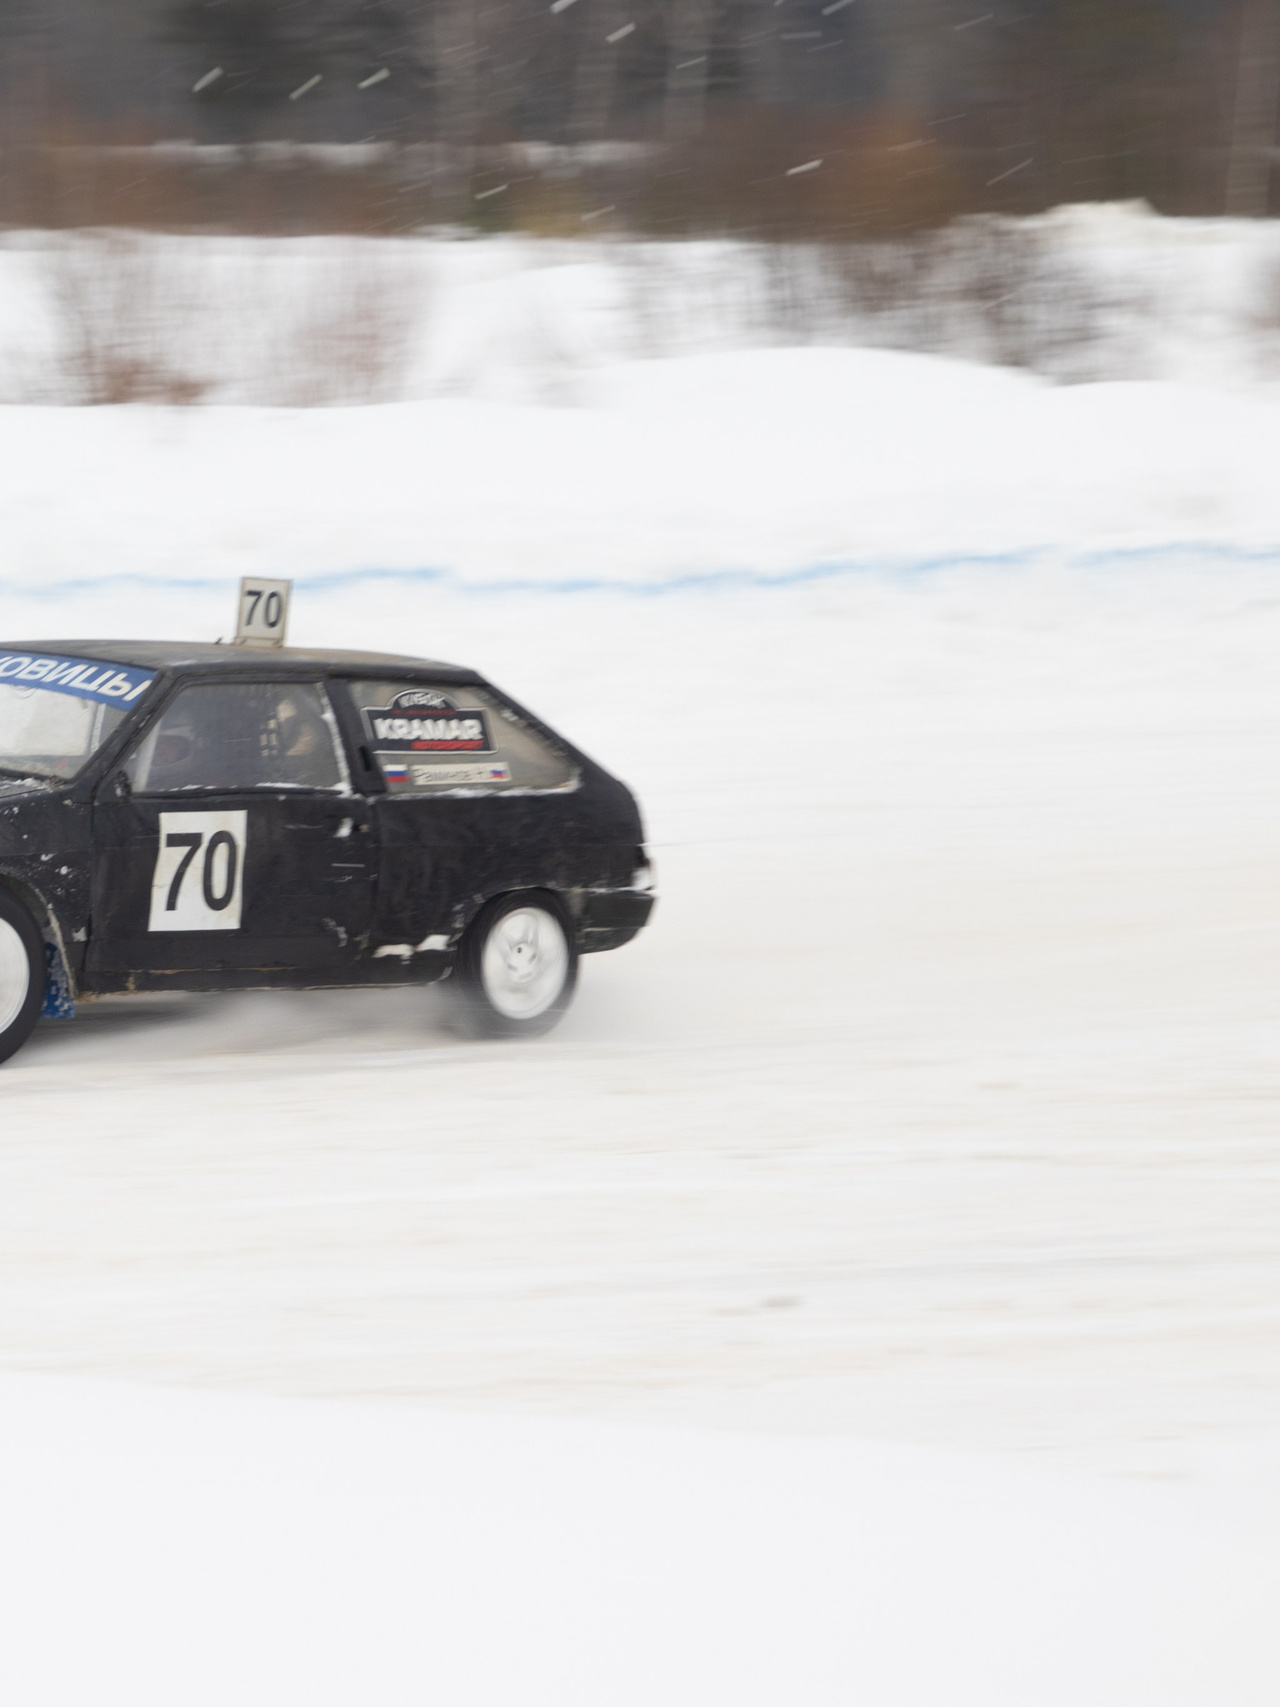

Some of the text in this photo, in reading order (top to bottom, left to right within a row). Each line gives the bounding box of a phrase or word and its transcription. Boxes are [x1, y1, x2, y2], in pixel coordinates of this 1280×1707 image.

[245, 590, 283, 628] 70
[373, 718, 484, 740] KRAMAR
[165, 830, 237, 911] 70
